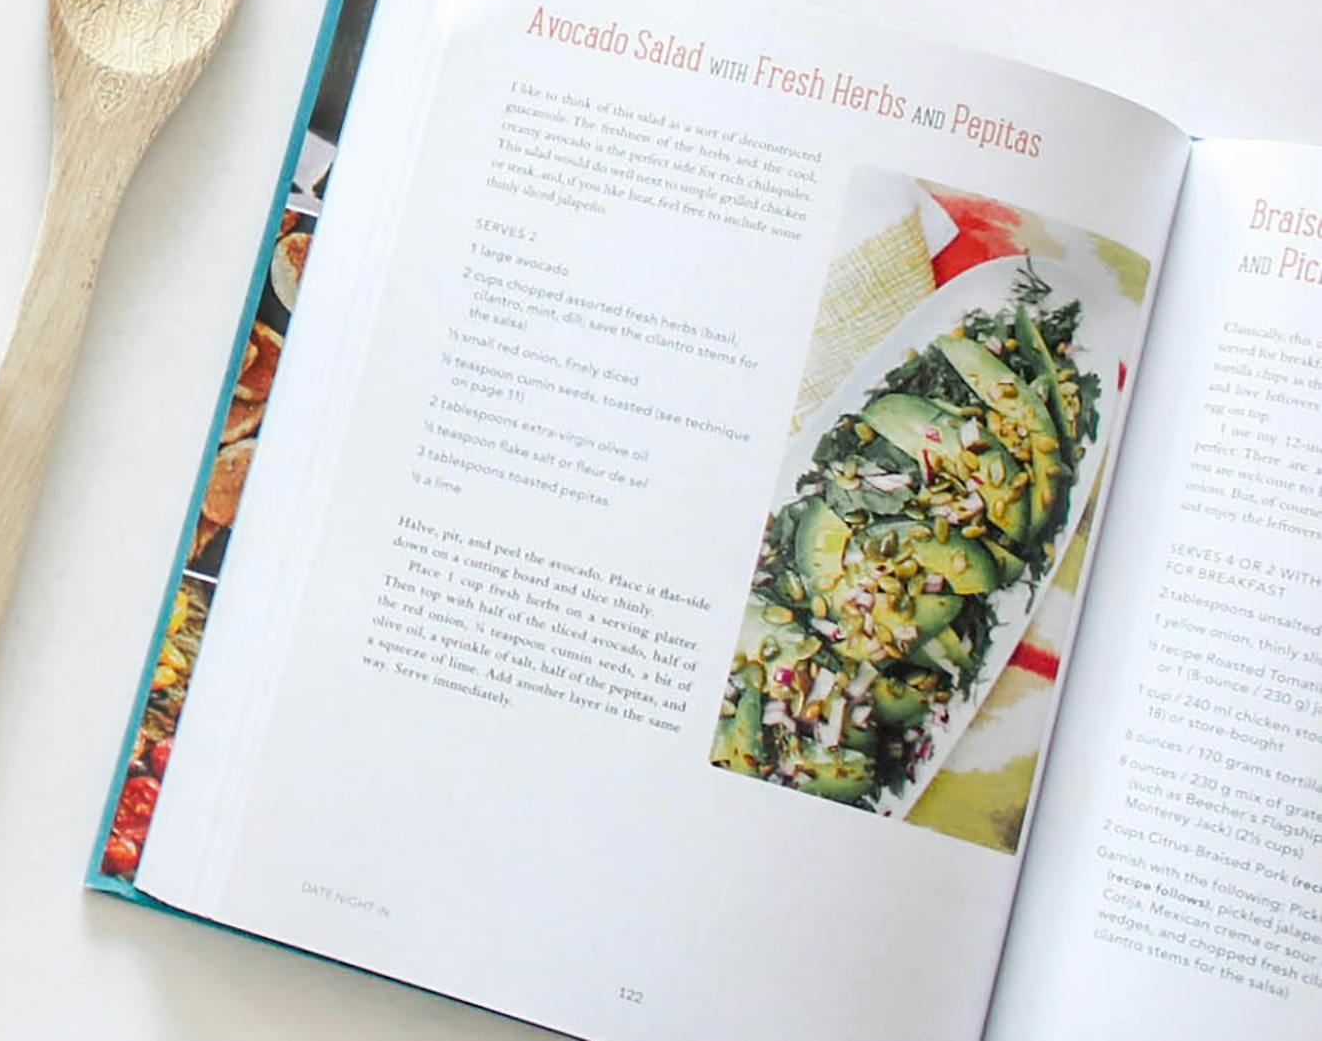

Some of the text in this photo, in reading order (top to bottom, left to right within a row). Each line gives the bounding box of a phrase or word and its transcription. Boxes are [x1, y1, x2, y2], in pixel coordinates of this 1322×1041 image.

[527, 5, 1043, 158] Avocado Salad WITH Fresh Herbs AND Pepitas
[475, 218, 526, 239] SERVES
[480, 244, 513, 263] large
[515, 257, 569, 276] avocado
[1238, 254, 1273, 276] AND
[473, 273, 503, 288] cups
[506, 279, 565, 302] chopped
[565, 295, 623, 316] assorted
[625, 307, 658, 325] fresh
[660, 315, 697, 335] herbs
[455, 357, 514, 385] teaspoon
[516, 374, 556, 391] cumin
[602, 395, 654, 417] toasted
[685, 417, 750, 442] technique
[428, 449, 609, 507] tablespoons toasted pepitas
[393, 535, 428, 554] down
[432, 549, 449, 560] on
[452, 554, 459, 563] a
[463, 558, 510, 579] cutting
[512, 567, 550, 587] board
[553, 583, 578, 594] and
[581, 587, 609, 602] slice
[408, 560, 441, 579] Place
[448, 571, 454, 582] 1
[460, 578, 484, 593] cup
[489, 583, 520, 601] fresh
[525, 592, 560, 612] herbs
[565, 607, 582, 618] on
[588, 613, 596, 622] a
[601, 617, 650, 640] serving
[468, 538, 492, 551] and
[493, 545, 521, 559] peel
[524, 551, 545, 565] the
[609, 573, 643, 592] Place
[646, 583, 656, 596] it
[659, 587, 711, 610] flat-side
[378, 595, 397, 609] the
[402, 604, 424, 616] red
[490, 628, 546, 651] teaspoon
[550, 646, 592, 664] cumin
[654, 671, 673, 686] bit
[677, 681, 693, 691] of
[385, 574, 416, 593] Then
[420, 586, 441, 602] top
[446, 595, 474, 609] with
[478, 600, 507, 618] half
[507, 612, 525, 623] of
[526, 615, 546, 629] the
[551, 622, 588, 641] sliced
[652, 649, 681, 666] half
[682, 662, 697, 671] of
[367, 637, 374, 645] a
[378, 640, 427, 660] squeeze
[431, 654, 448, 665] of
[485, 667, 513, 684] Add
[516, 679, 566, 699] another
[569, 690, 602, 710] layer
[604, 701, 618, 714] in
[623, 707, 644, 721] the
[648, 717, 681, 731] same
[372, 615, 402, 631] olive
[430, 633, 437, 642] a
[441, 636, 491, 657] sprinkle
[494, 650, 511, 661] of
[540, 660, 568, 678] half
[568, 672, 585, 682] of
[585, 675, 606, 689] the
[662, 699, 687, 711] and
[394, 662, 429, 681] Serve
[619, 987, 644, 1004] 122
